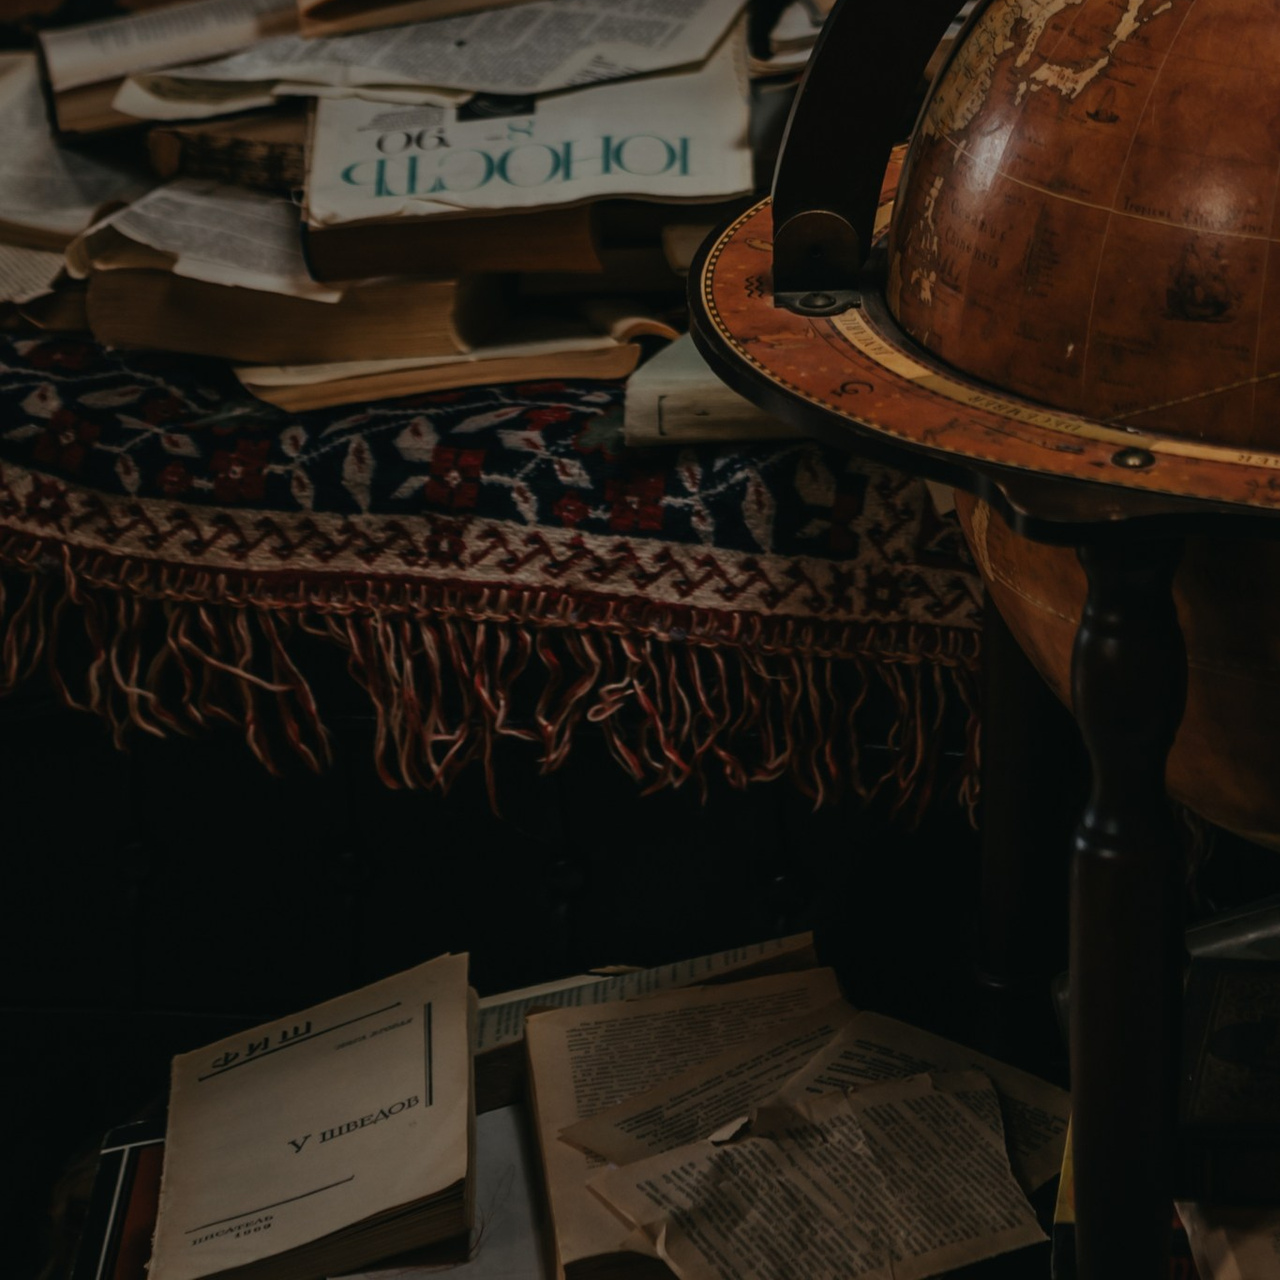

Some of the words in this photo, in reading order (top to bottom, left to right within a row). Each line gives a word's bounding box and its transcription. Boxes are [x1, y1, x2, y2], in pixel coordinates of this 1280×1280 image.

[340, 135, 692, 198] ЮНОСТЬ
[210, 1020, 312, 1070] ФИШ
[288, 1134, 312, 1154] У
[318, 1095, 421, 1145] ШВЕДОВ
[191, 1214, 274, 1247] ПИСАТЕЛЬ
